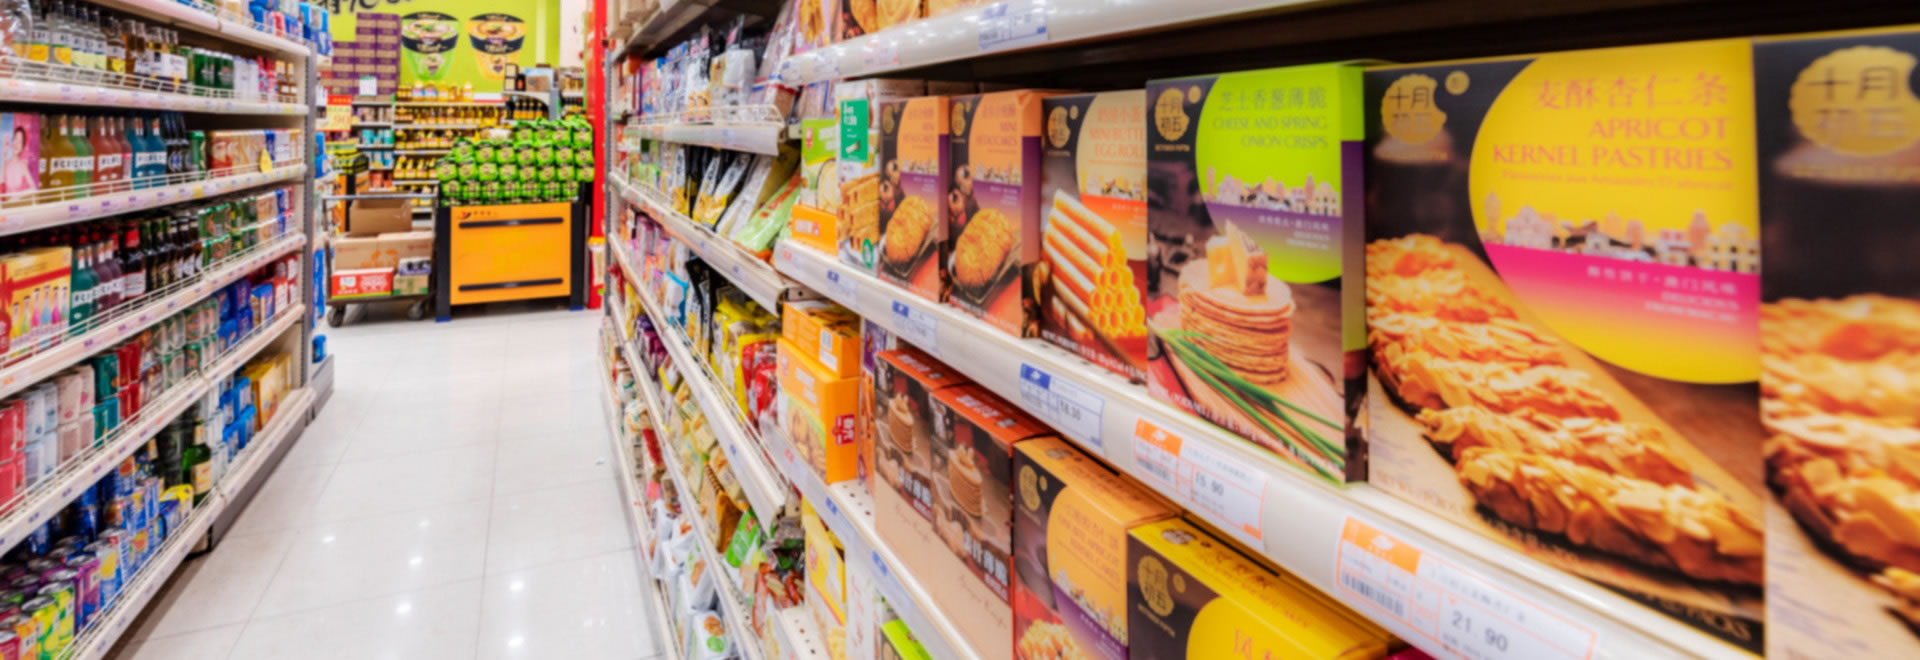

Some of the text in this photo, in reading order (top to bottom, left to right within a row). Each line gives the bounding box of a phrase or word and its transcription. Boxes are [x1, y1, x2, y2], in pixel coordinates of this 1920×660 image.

[1533, 72, 1729, 111] 麦酥杏仁条
[1805, 65, 1902, 102] 十月
[1388, 85, 1431, 110] 十月
[1212, 116, 1328, 131] CHEESE AND SPRING
[1588, 116, 1733, 141] APRICOT
[1240, 134, 1328, 149] ONION CRISPS
[1492, 143, 1735, 171] KERNEL PASTRIES
[1451, 609, 1509, 653] 21.90
